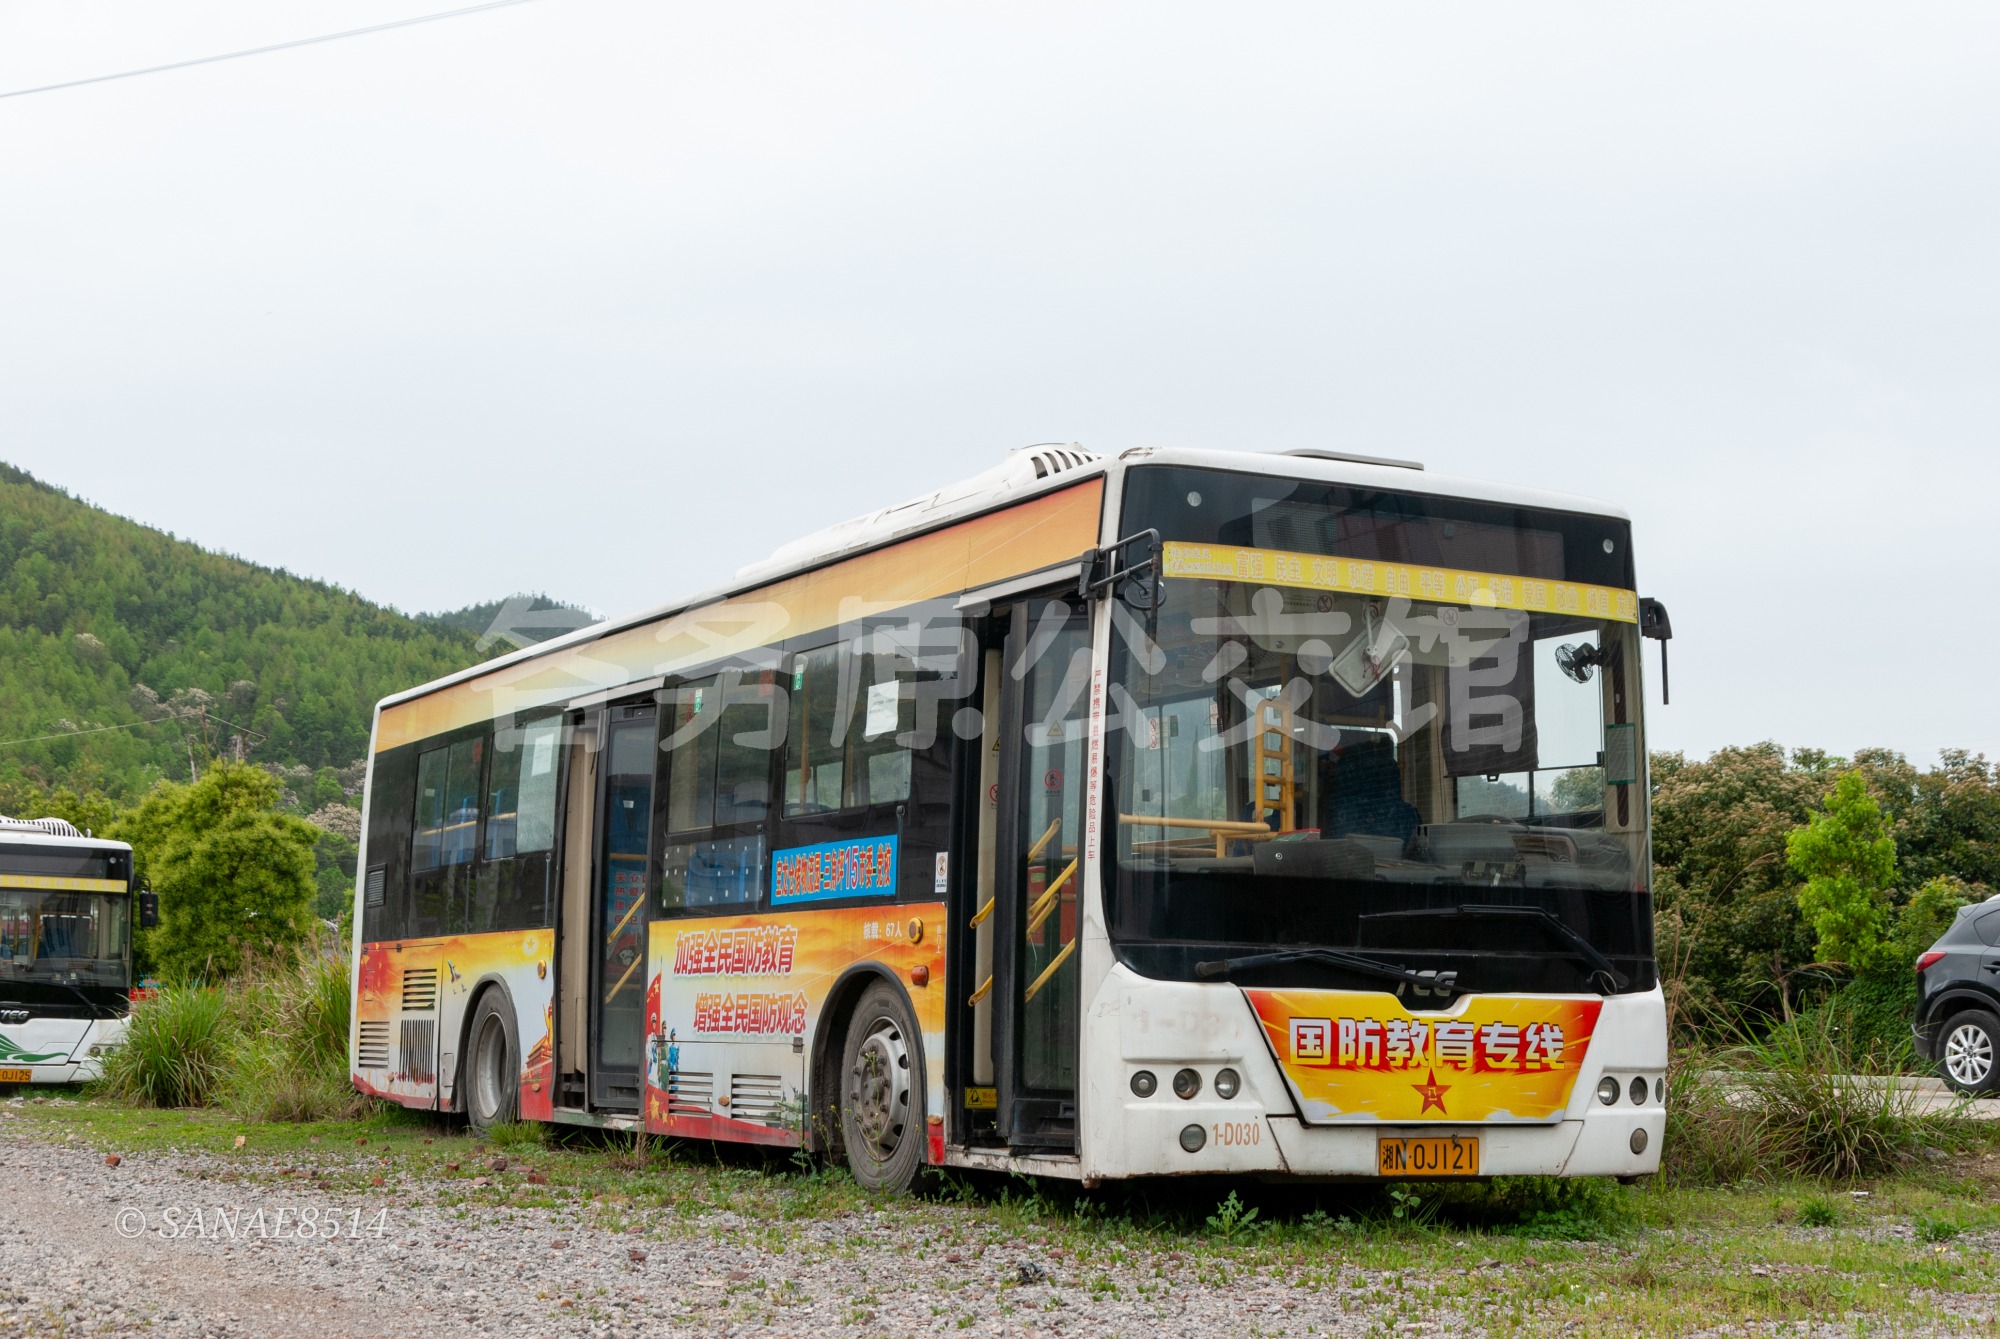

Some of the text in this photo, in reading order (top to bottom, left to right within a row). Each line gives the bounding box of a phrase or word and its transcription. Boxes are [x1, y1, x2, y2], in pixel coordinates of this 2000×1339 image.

[1236, 550, 1264, 579] 富强
[1275, 555, 1302, 582] 民主
[1312, 558, 1338, 587] 文明
[1349, 562, 1374, 591] 和谐
[1386, 566, 1410, 594] 自由
[1420, 570, 1445, 597] 平等
[1455, 573, 1479, 600] 公正
[1522, 580, 1547, 608] 爱国
[614, 886, 646, 897] 热爱
[674, 925, 798, 977] 加强全民国防教育
[693, 989, 808, 1037] 增强全民国防观念
[1289, 1017, 1565, 1070] 国防教育专线
[1211, 1122, 1260, 1147] 1-D030
